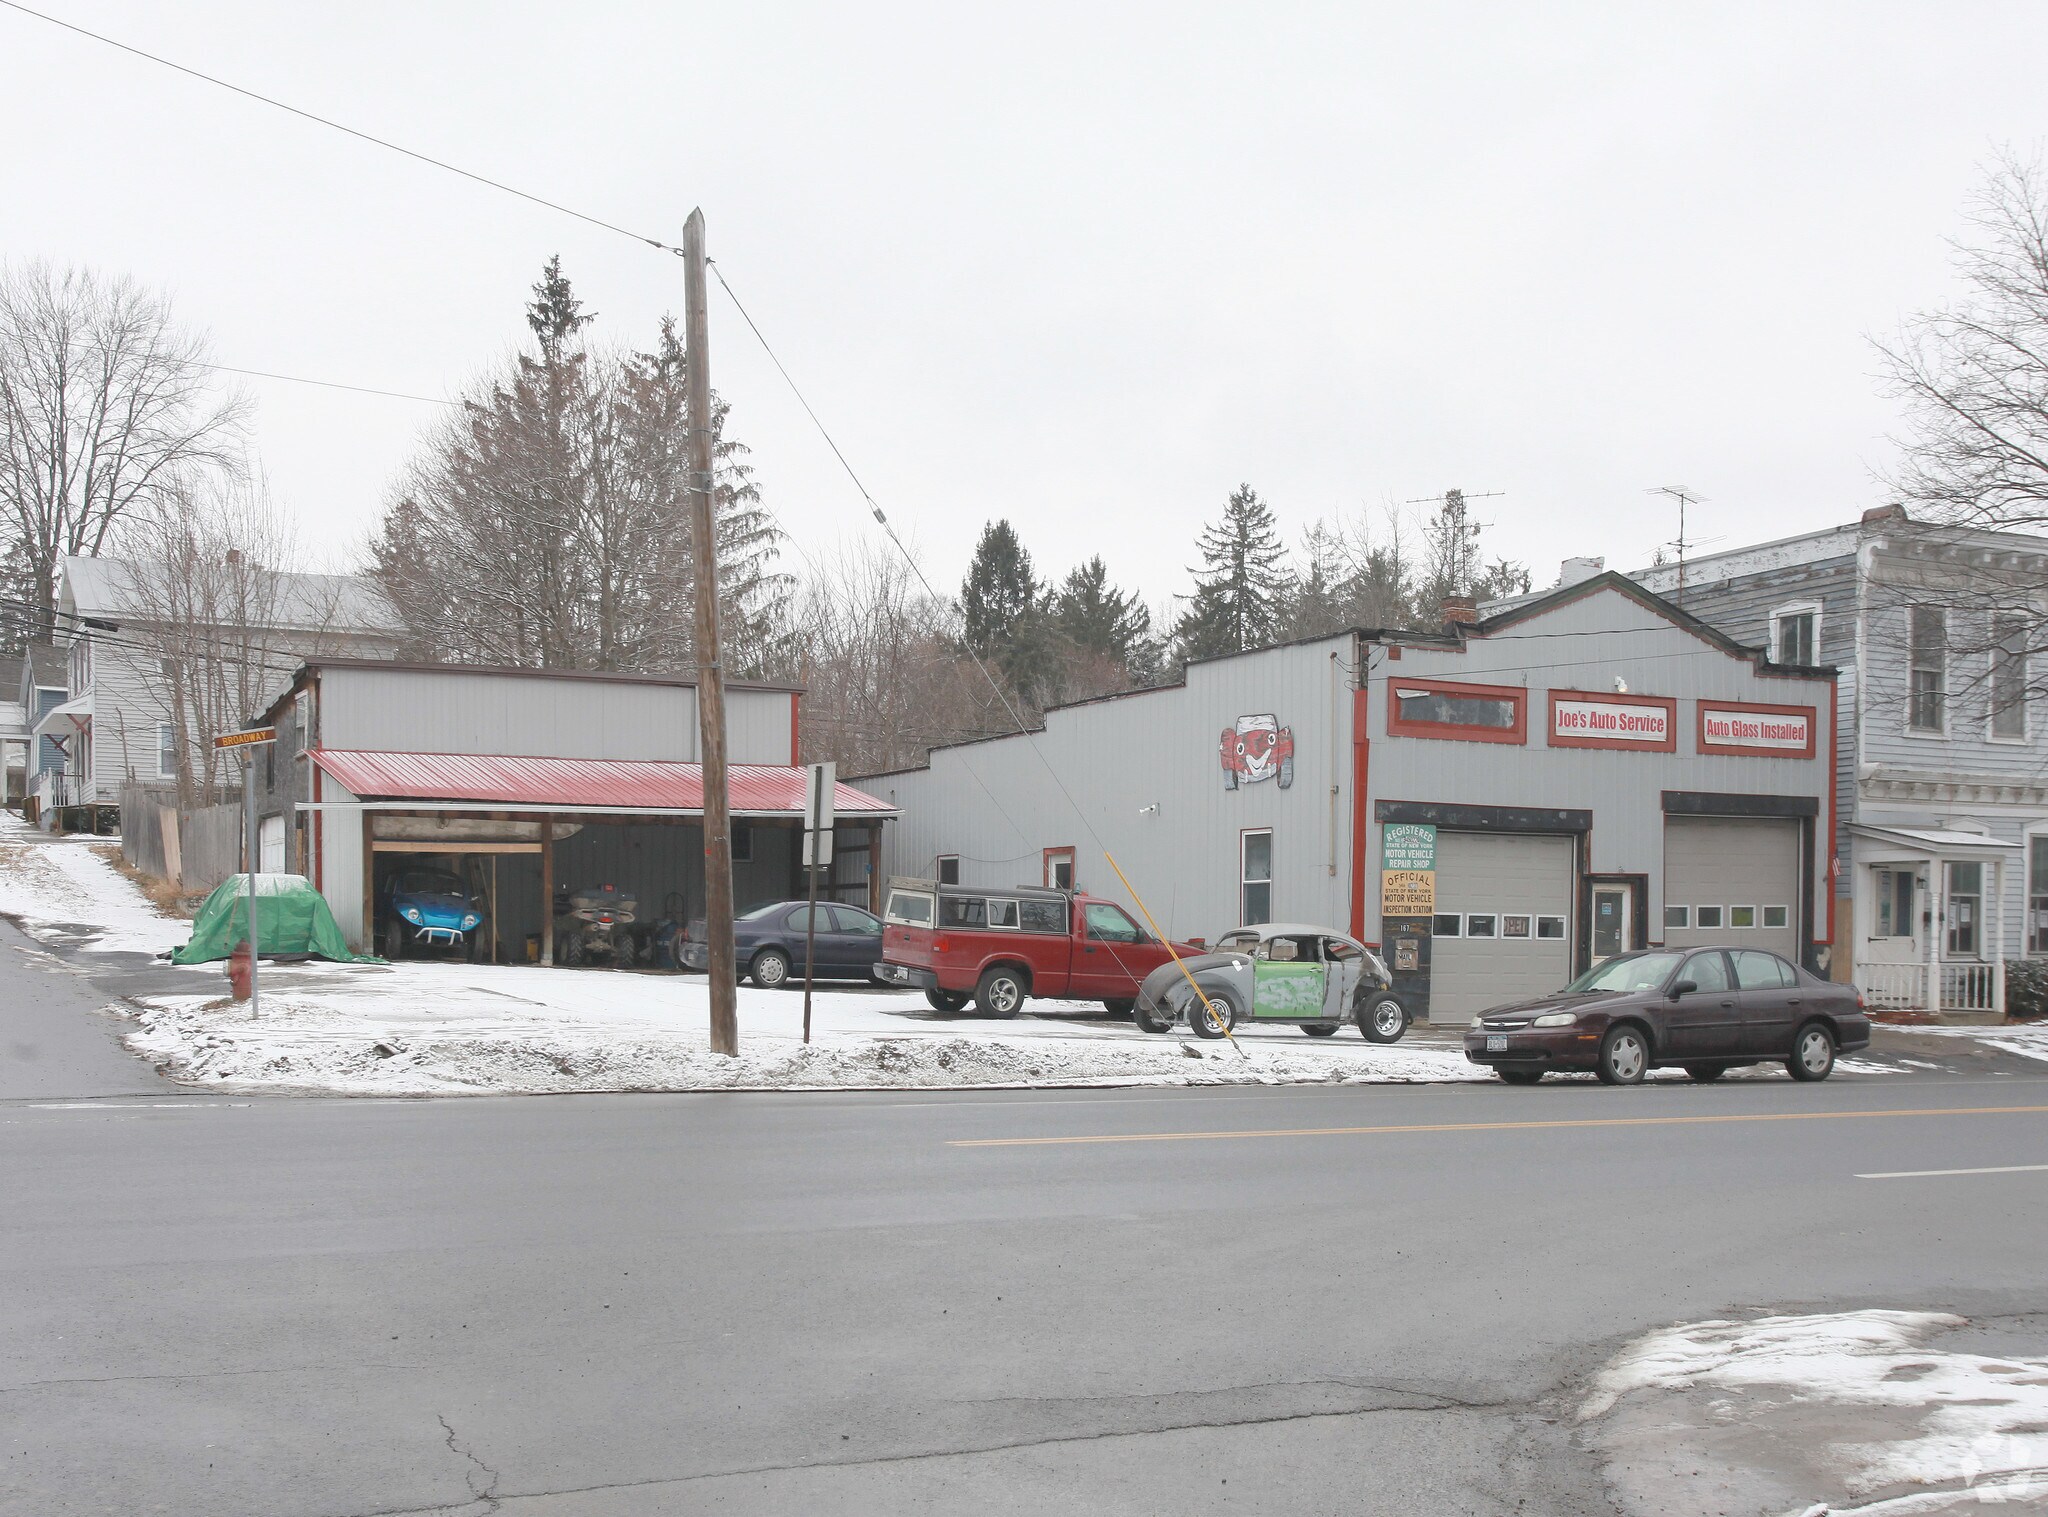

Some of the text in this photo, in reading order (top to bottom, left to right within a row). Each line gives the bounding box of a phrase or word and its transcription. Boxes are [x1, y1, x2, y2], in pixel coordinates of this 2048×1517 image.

[1558, 709, 1665, 733] Joe's Auto Service
[1707, 719, 1805, 741] Auto Glass Installed
[221, 731, 267, 746] BROADWAY
[1386, 826, 1433, 842] REGISTERED
[1385, 849, 1434, 859] MOTOR VEHICLE
[1389, 859, 1430, 869] REPAIR SHOP
[1387, 872, 1431, 886] OFFICIAL
[1384, 894, 1432, 903] MOTOR VEHICLE
[1383, 905, 1433, 914] INSPECTION STATION
